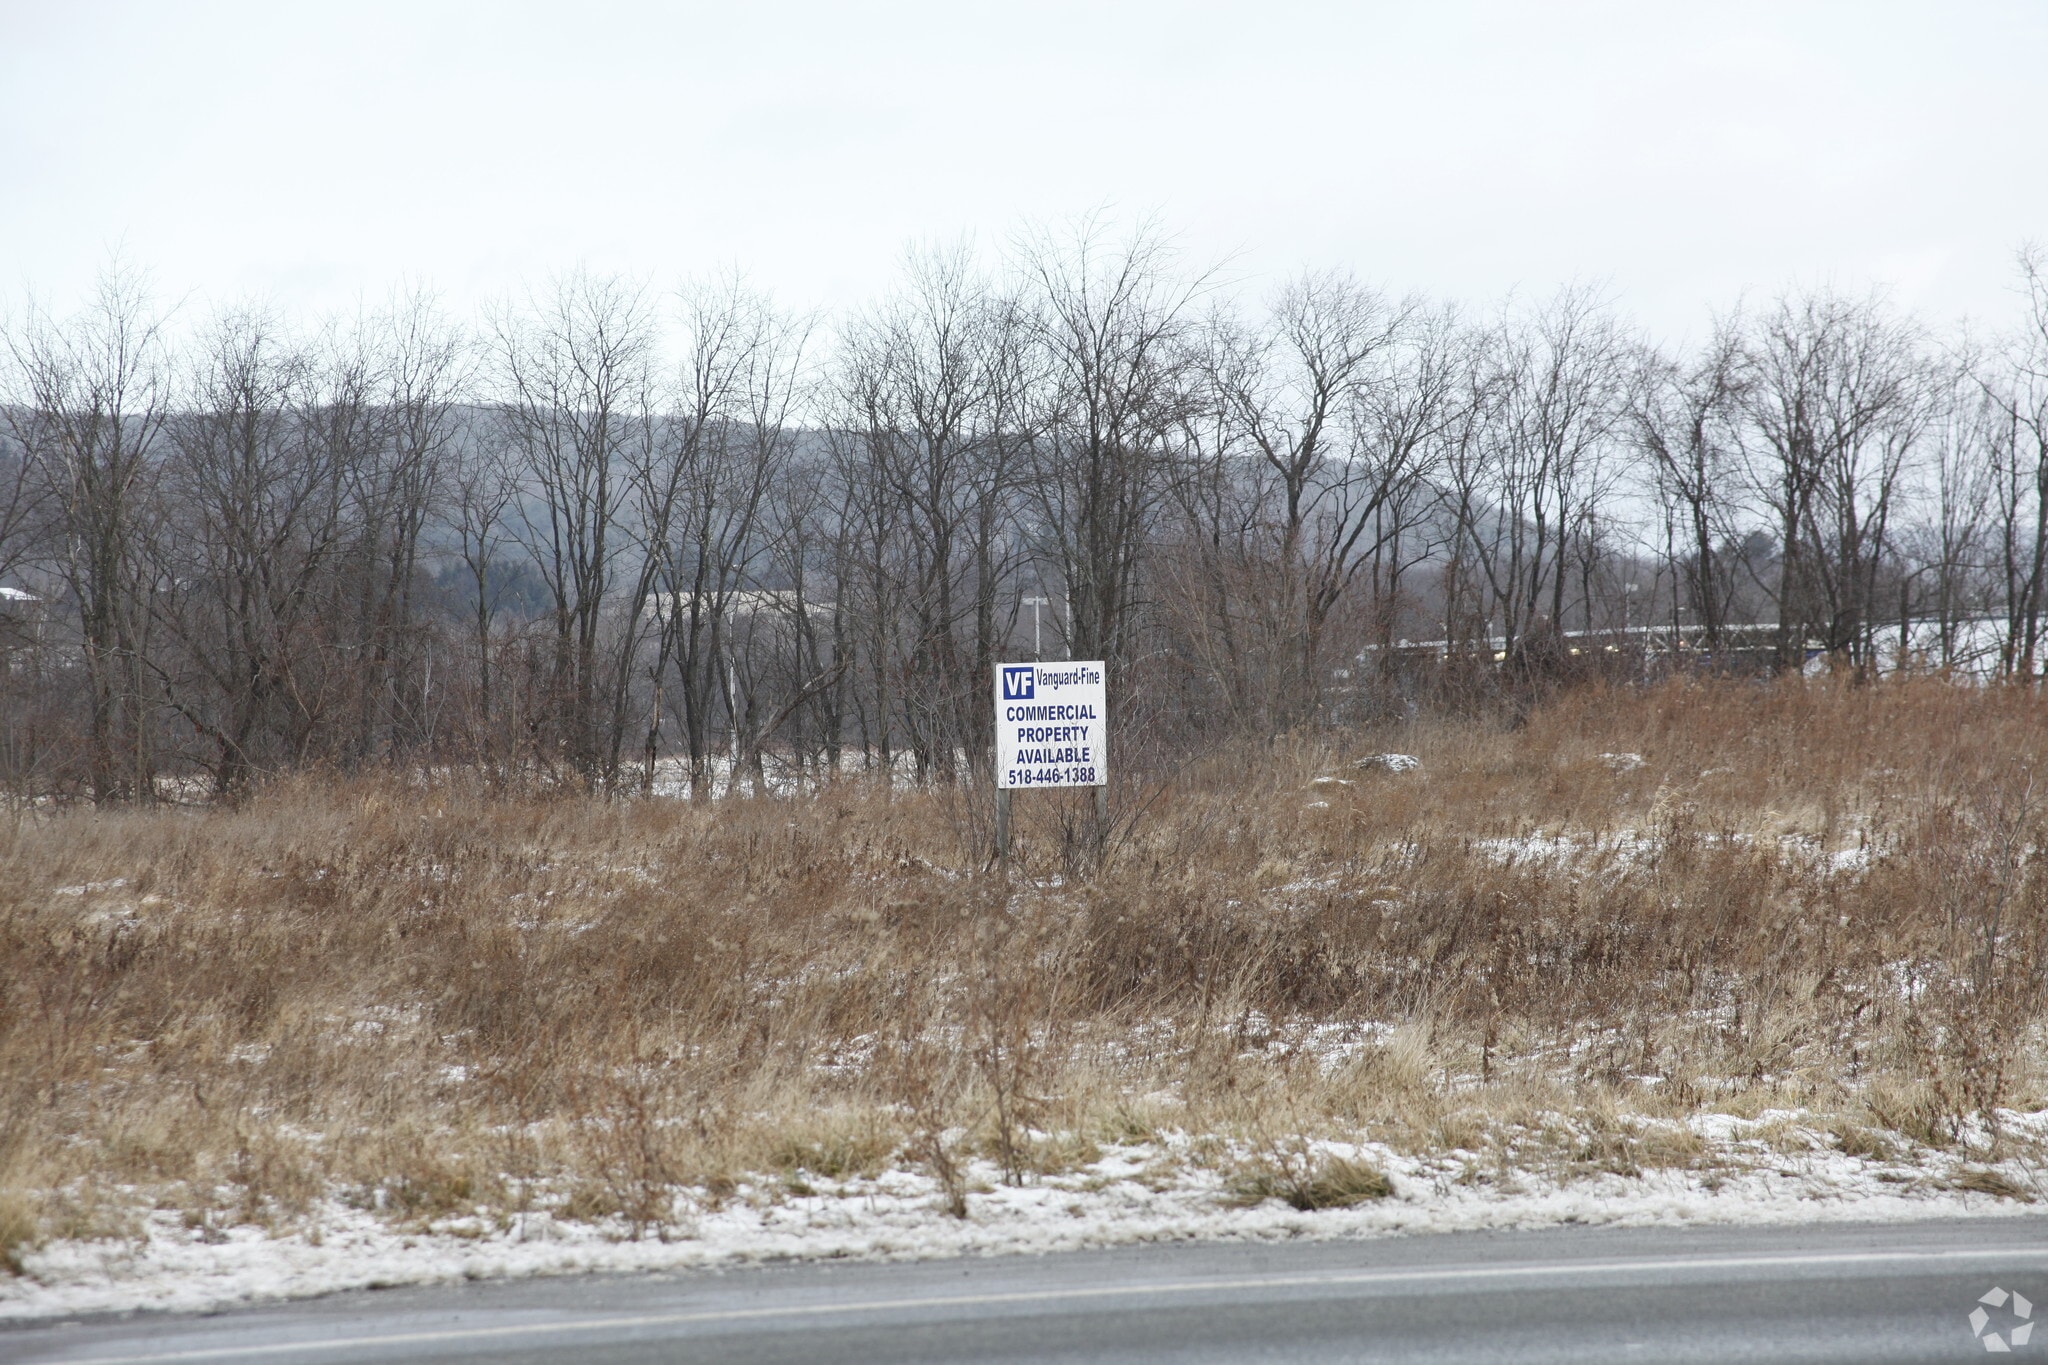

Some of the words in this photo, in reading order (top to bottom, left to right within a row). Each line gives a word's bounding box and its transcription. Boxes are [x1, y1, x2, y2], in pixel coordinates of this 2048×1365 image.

[1005, 672, 1033, 696] VF
[1036, 667, 1100, 691] Vanguard-Fine
[1006, 704, 1097, 722] COMMERCIAL
[1018, 726, 1089, 743] PROPERTY
[1016, 747, 1091, 765] AVAILABLE
[1008, 767, 1096, 785] 518-446-1388
